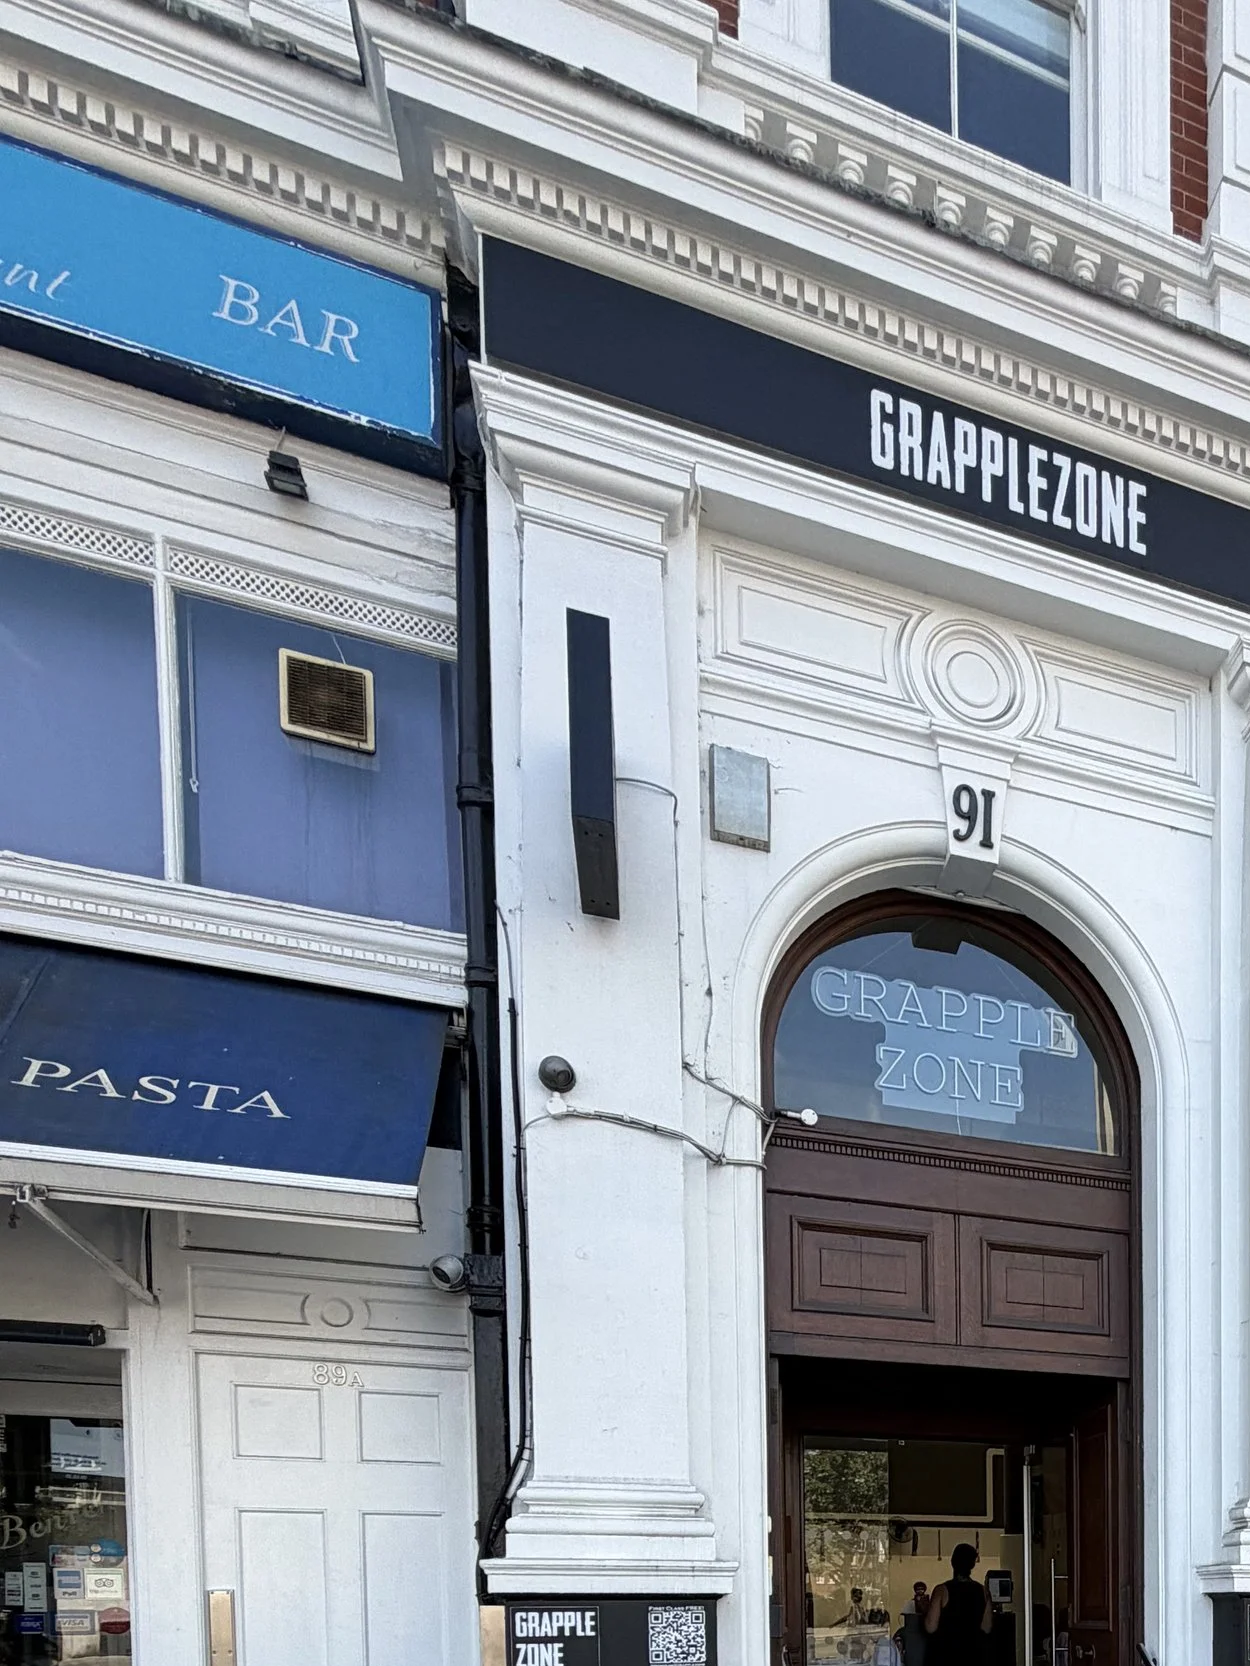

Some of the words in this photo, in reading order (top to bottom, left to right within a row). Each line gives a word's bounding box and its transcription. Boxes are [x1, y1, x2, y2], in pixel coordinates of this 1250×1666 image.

[212, 274, 360, 363] BAR
[870, 388, 1147, 556] GRAPPLEZONE
[953, 784, 995, 850] 91
[815, 967, 1076, 1055] GRAPPLE
[10, 1056, 292, 1119] PASTA
[877, 1047, 1023, 1108] ZONE
[313, 1363, 364, 1387] 89A
[515, 1612, 595, 1637] GRAPPLE
